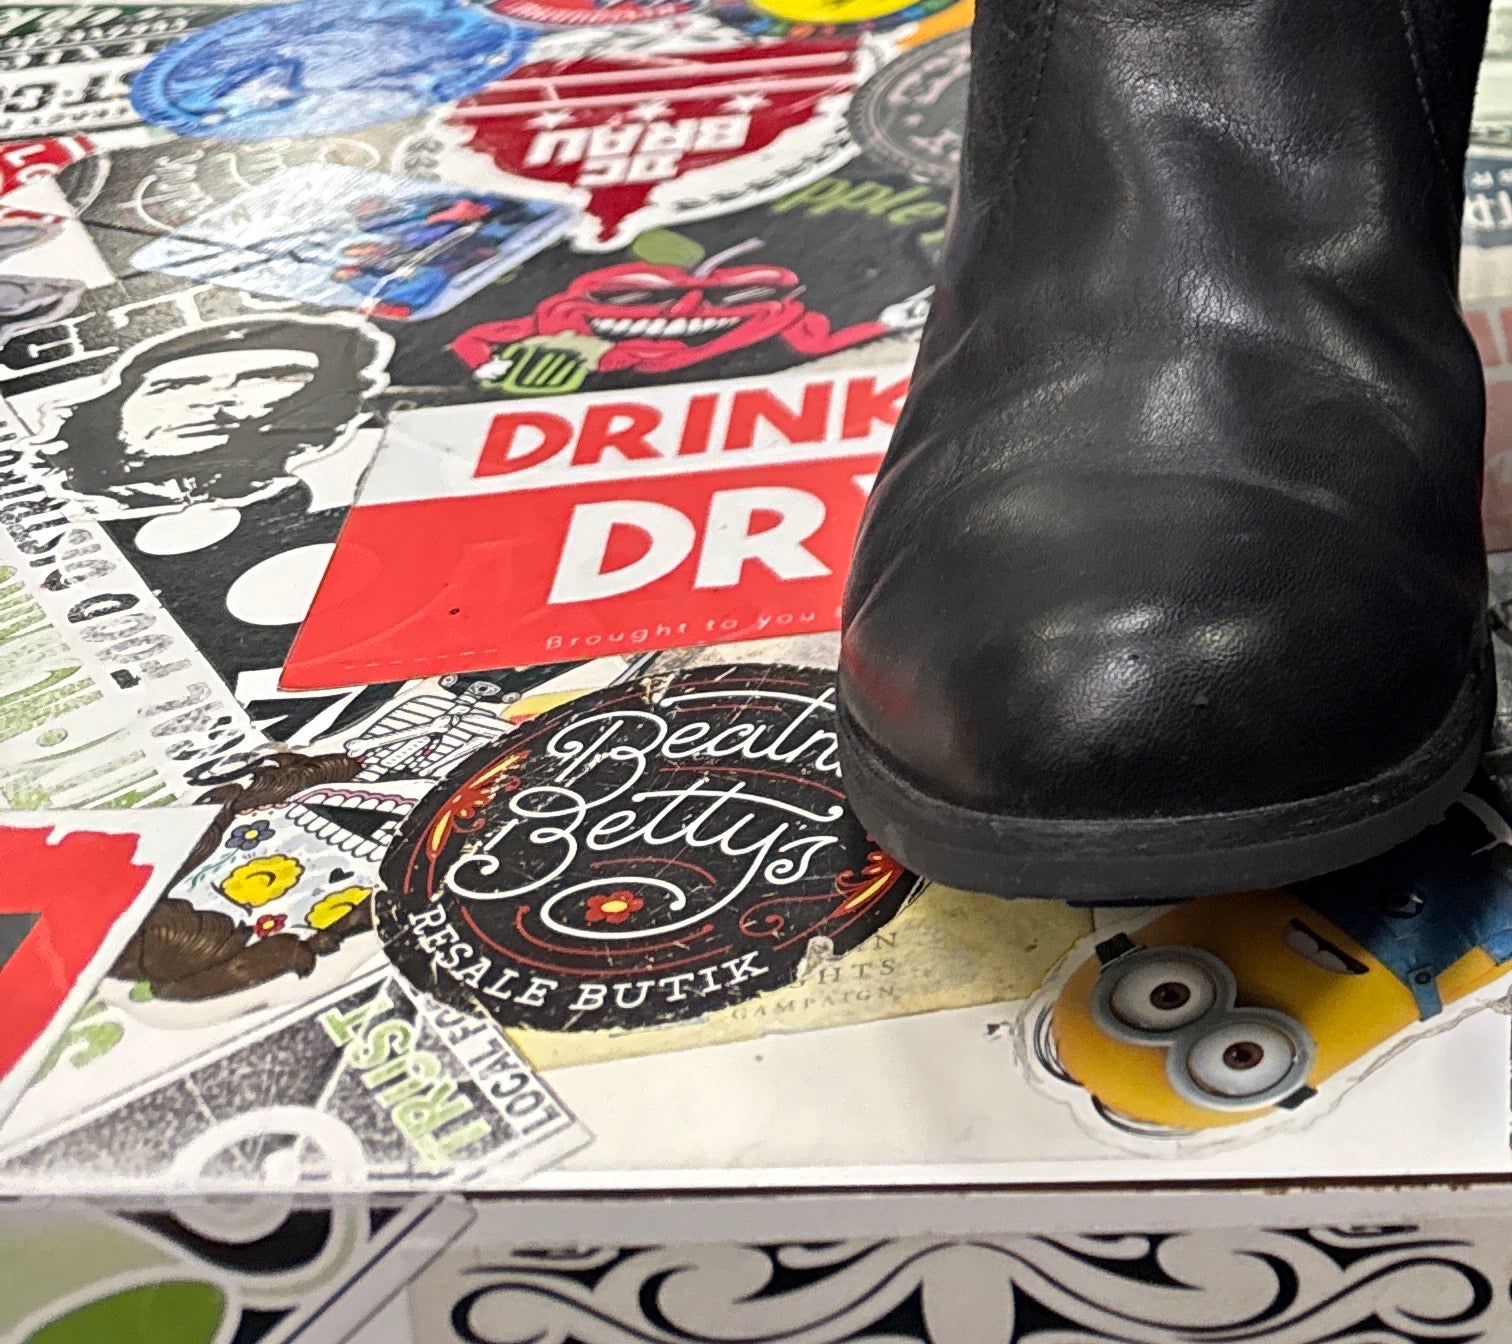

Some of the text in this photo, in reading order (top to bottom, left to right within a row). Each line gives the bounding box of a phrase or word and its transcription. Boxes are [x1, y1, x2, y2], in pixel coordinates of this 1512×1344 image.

[525, 115, 752, 167] BRAU
[577, 152, 682, 185] DC
[547, 472, 876, 605] DR
[546, 612, 817, 650] Brought to you
[547, 687, 843, 808] Beatn
[408, 903, 771, 1014] RESALE BUTIK
[318, 992, 492, 1160] TRUST
